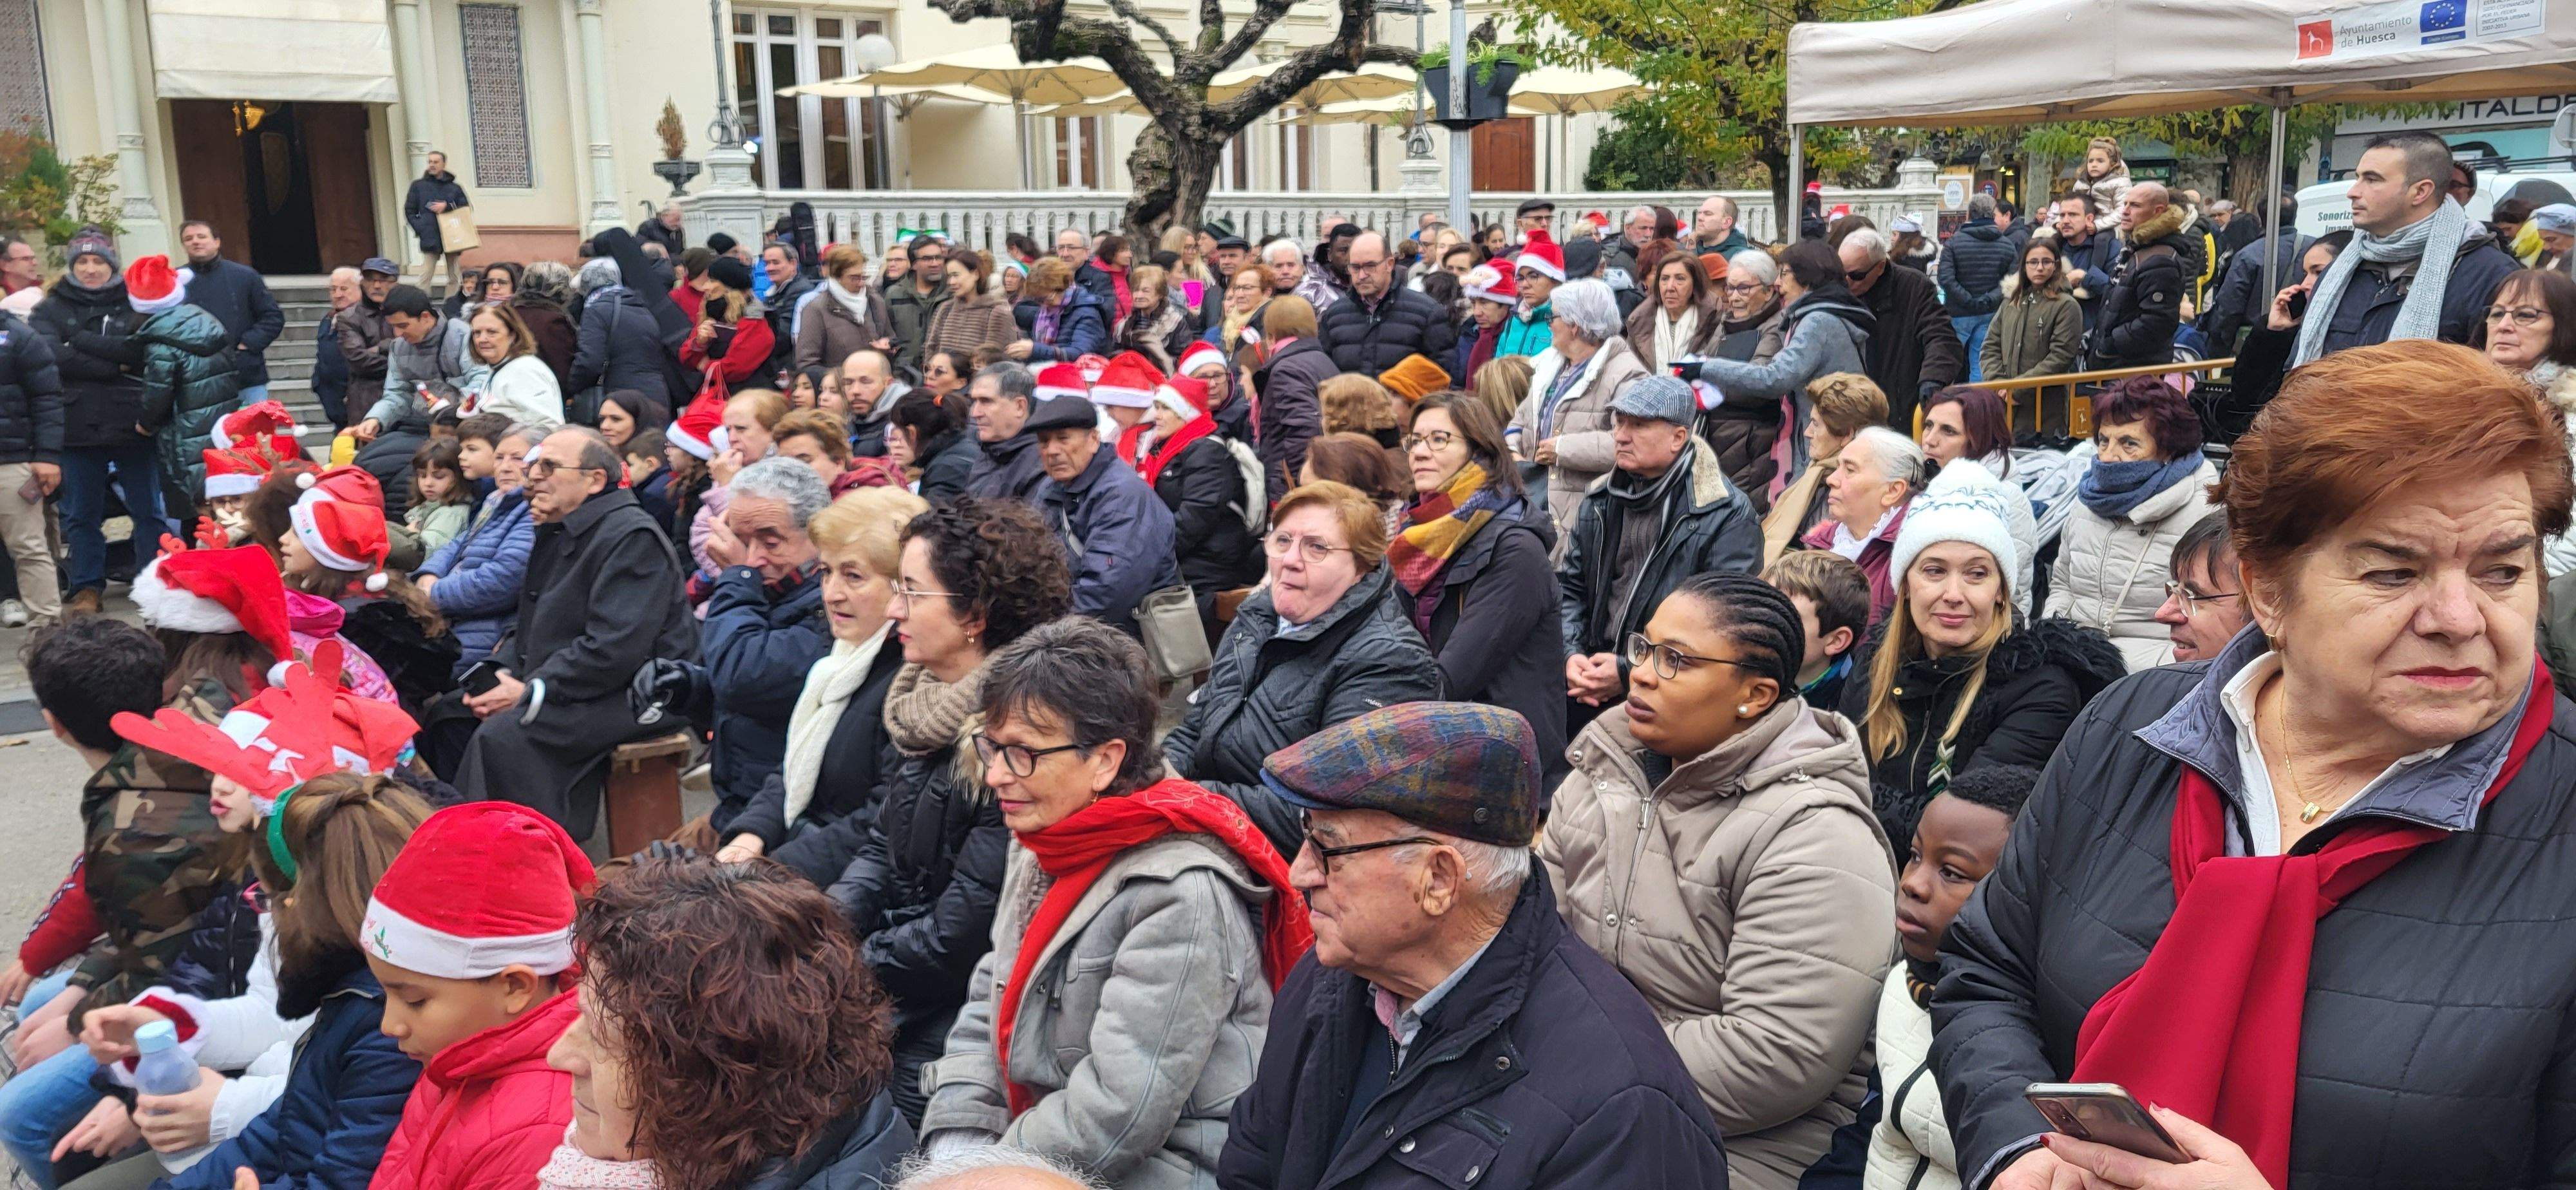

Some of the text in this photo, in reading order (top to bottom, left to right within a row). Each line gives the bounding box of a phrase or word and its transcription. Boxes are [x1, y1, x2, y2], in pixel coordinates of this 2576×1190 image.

[2340, 17, 2412, 37] Ayuntamiento
[2341, 32, 2396, 48] de Huesca
